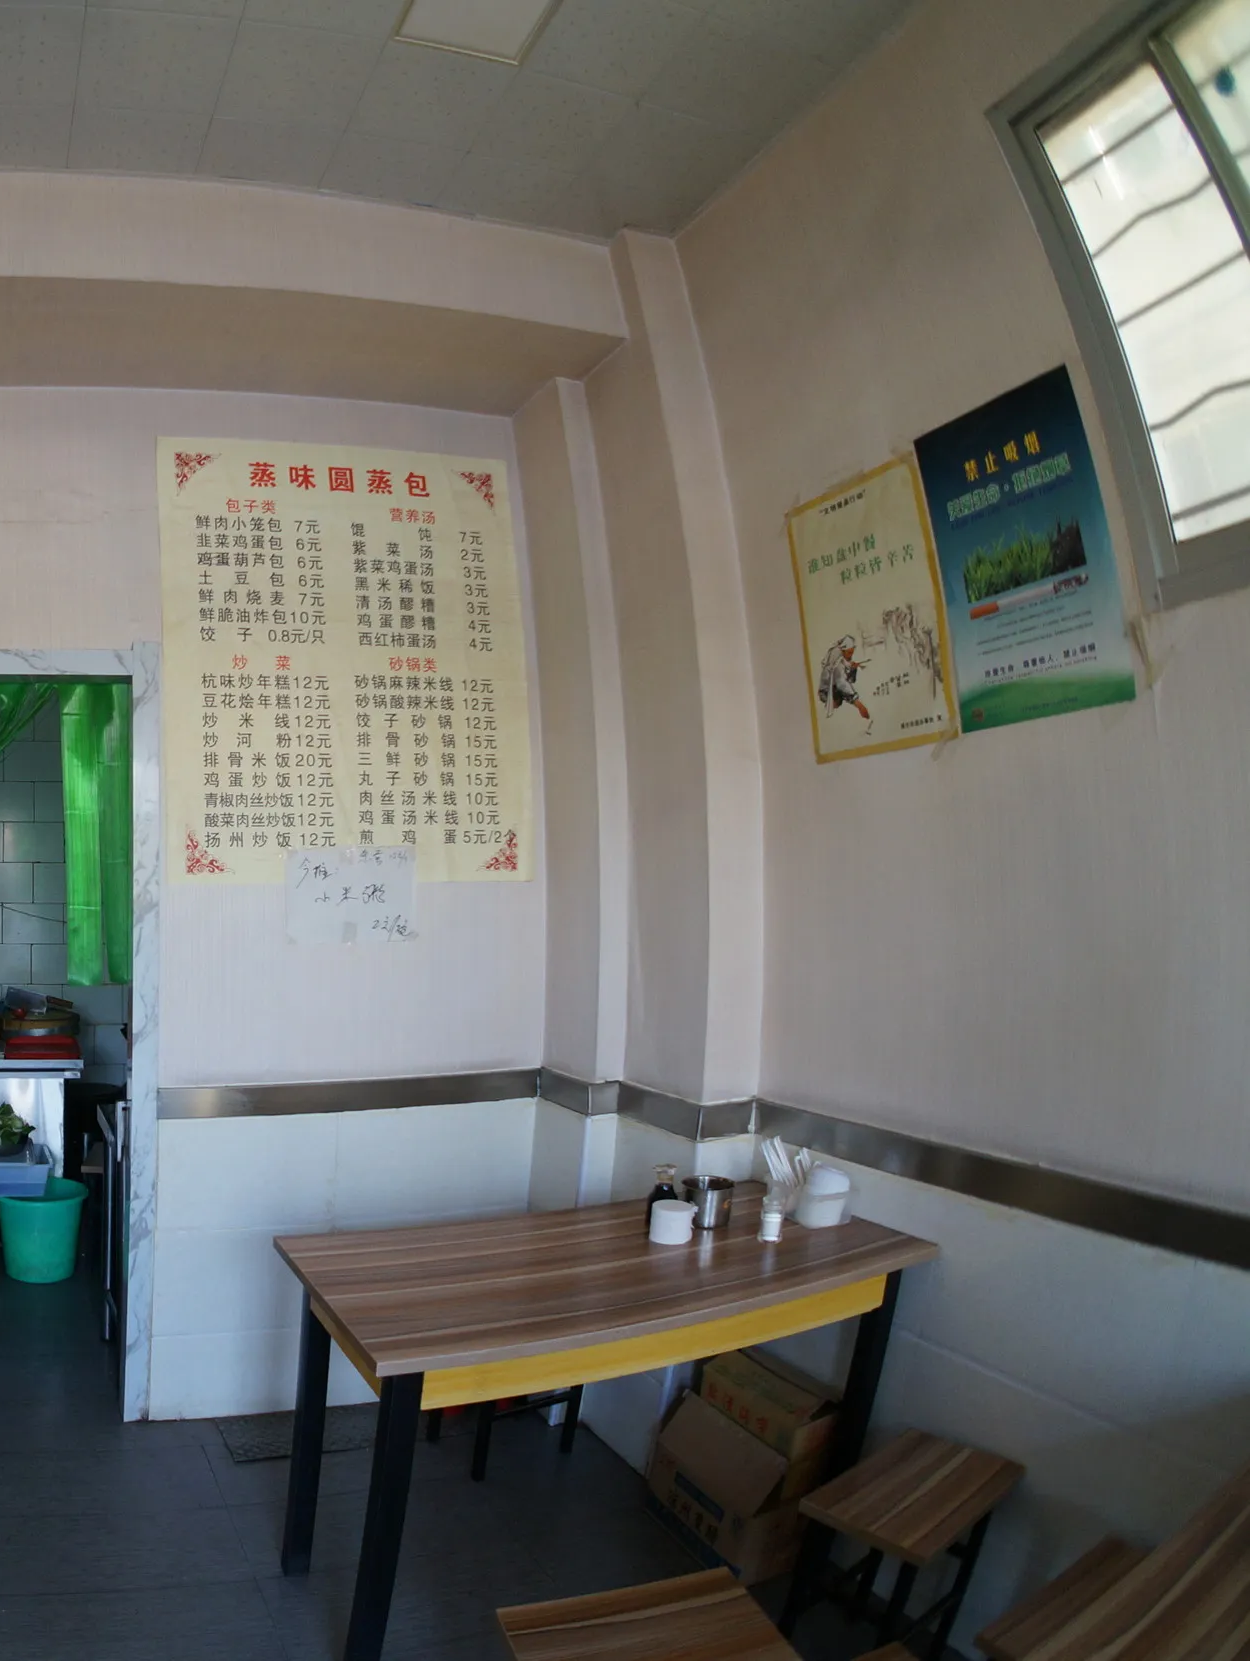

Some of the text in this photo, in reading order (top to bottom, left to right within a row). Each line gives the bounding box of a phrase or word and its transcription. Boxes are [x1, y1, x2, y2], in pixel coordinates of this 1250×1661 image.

[963, 430, 1041, 482] 禁止吸烟
[249, 462, 431, 498] 蒸味圆蒸包
[226, 498, 276, 514] 包子类
[389, 508, 436, 524] 营养汤
[196, 515, 320, 534] 鲜肉小笼包 7元
[197, 534, 322, 552] 韭菜鸡蛋包 6元
[459, 531, 483, 546] 7元
[352, 540, 484, 563] 紫菜汤 2元
[807, 534, 876, 575] 谁知盘中餐
[197, 552, 323, 570] 鸡蛋葫芦包 6元
[353, 558, 486, 580] 紫菜鸡蛋汤 3元
[840, 544, 915, 585] 粒粒皆辛苦
[199, 572, 324, 588] 土豆包 6元
[354, 576, 488, 598] 黑米稀饭 3元
[199, 590, 325, 607] 鲜肉烧麦 7元
[200, 608, 326, 625] 鲜脆油炸包 10元
[467, 602, 490, 616] 3元
[468, 620, 491, 634] 4元
[200, 627, 325, 644] 饺子 0.8元/只
[358, 632, 493, 652] 西红柿蛋汤 4元
[232, 655, 290, 671] 炒菜
[389, 657, 437, 672] 砂锅类
[201, 674, 329, 690] 杭味炒年糕 12元
[355, 674, 494, 693] 砂锅麻辣米线 12元
[202, 694, 330, 709] 豆花烩年糕 12元
[356, 693, 495, 712] 砂锅酸辣米线 12元
[202, 713, 331, 729] 炒米线 12元
[357, 713, 497, 731] 饺子砂锅 12元
[203, 733, 331, 748] 炒河粉 12元
[357, 732, 497, 750] 排骨砂锅 15元
[204, 752, 332, 768] 排骨米饭 20元
[358, 752, 498, 768] 三鲜砂锅 15元
[204, 772, 334, 788] 鸡蛋炒饭 12元
[359, 771, 498, 788] 丸子砂锅 15元
[205, 792, 334, 808] 青椒肉丝炒饭 12元
[360, 791, 498, 806] 肉丝汤米线 10元
[205, 813, 335, 828] 酸菜肉丝炒饭 12元
[358, 810, 500, 826] 鸡蛋汤米线 10元
[205, 832, 336, 848] 扬州炒饭 12元
[360, 829, 456, 845] 煎鸡蛋
